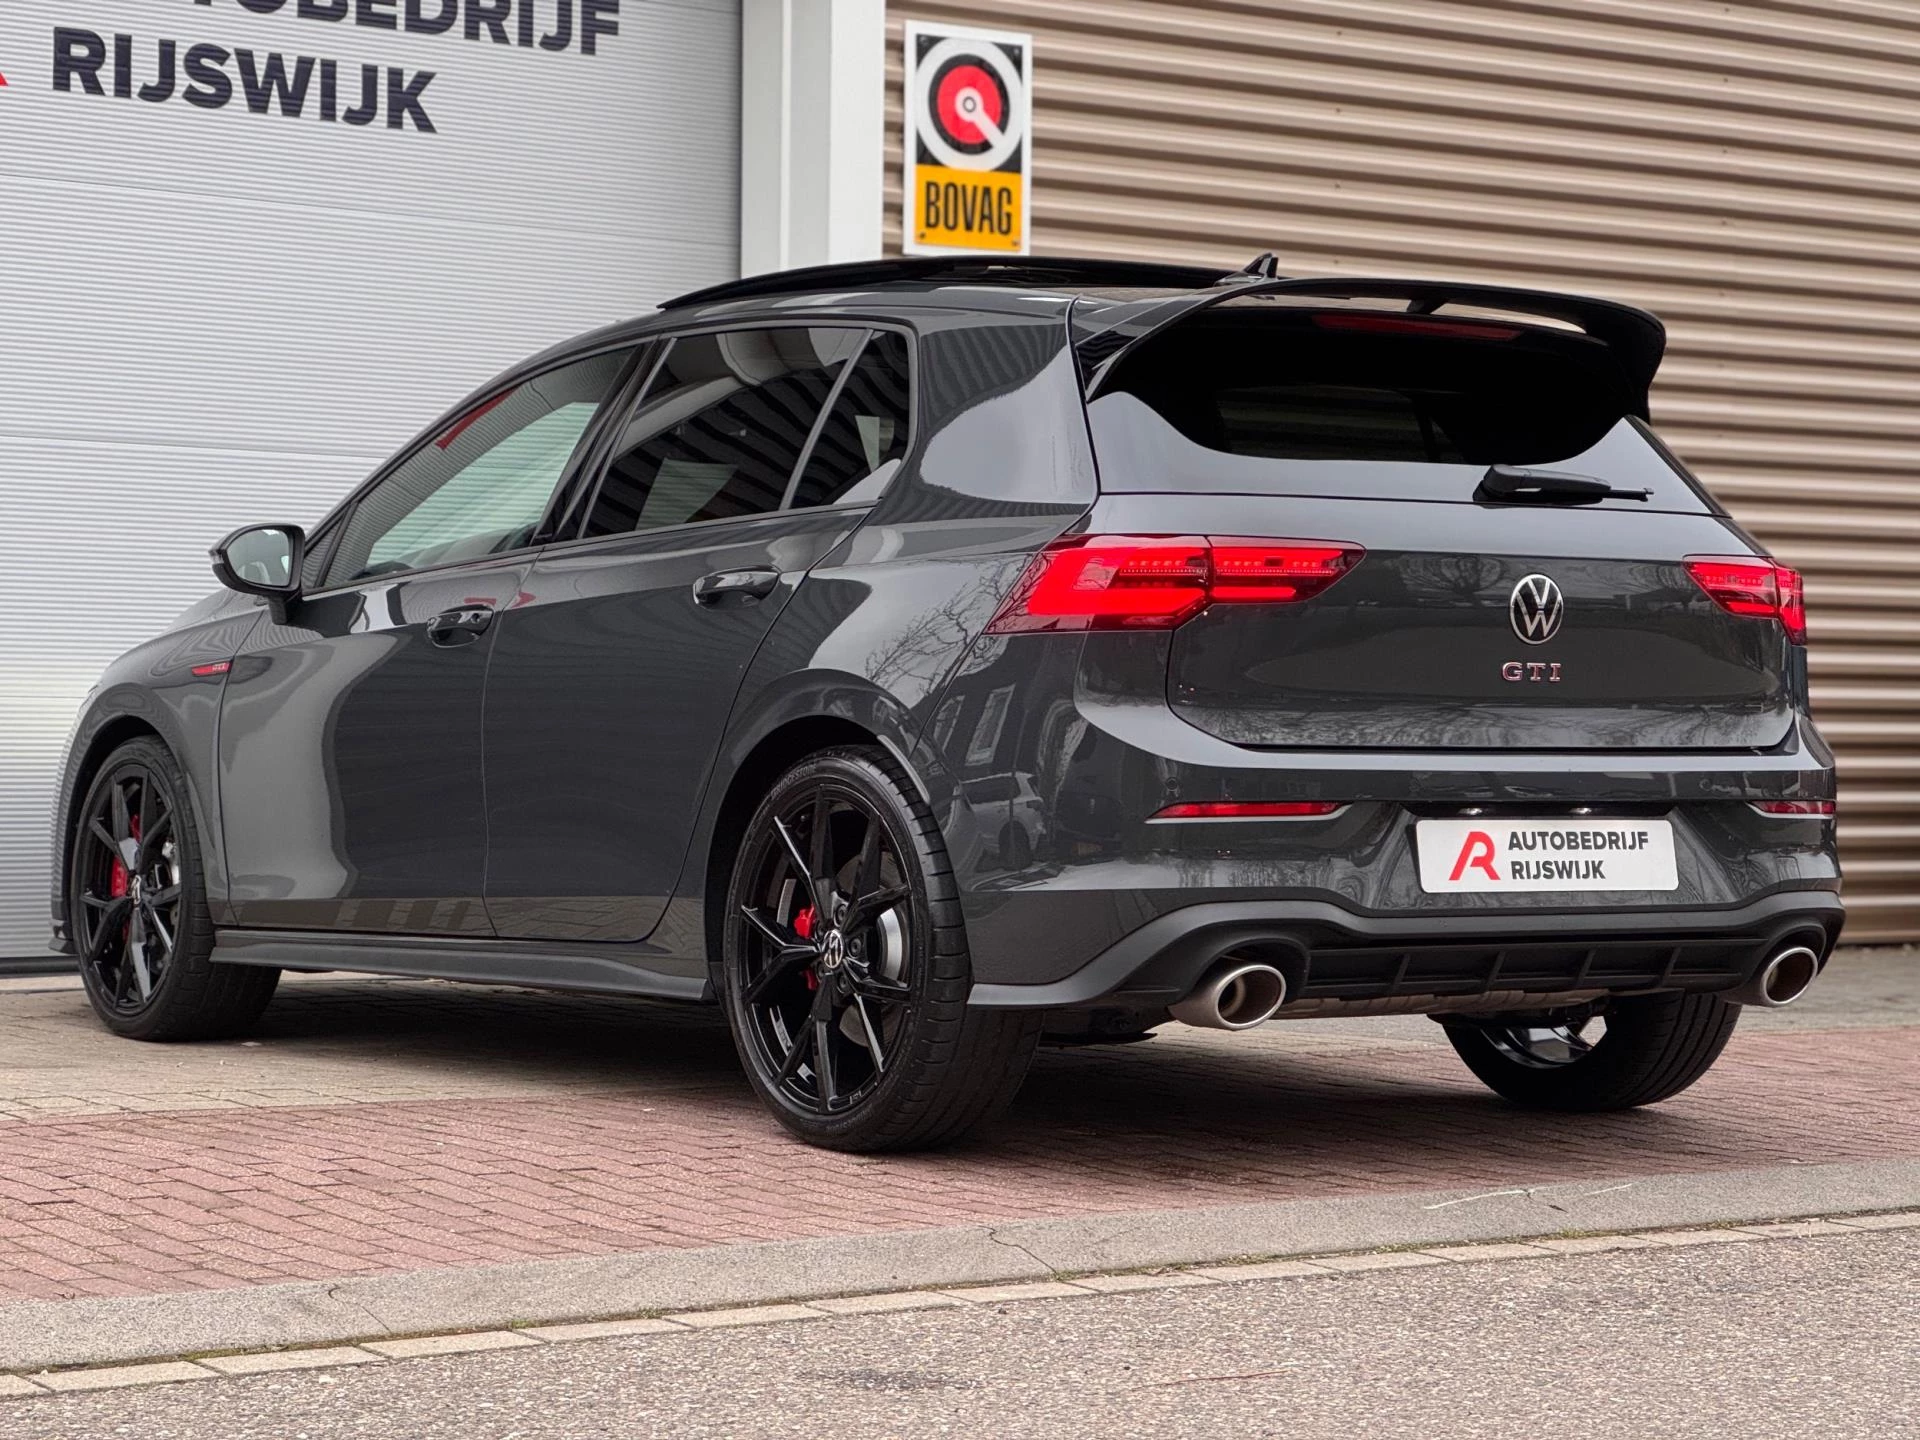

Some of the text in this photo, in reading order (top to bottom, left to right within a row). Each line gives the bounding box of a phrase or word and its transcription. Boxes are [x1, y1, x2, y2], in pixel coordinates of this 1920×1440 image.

[194, 0, 620, 56] DRIJF
[52, 26, 438, 134] RIJSWIJK
[924, 181, 1013, 236] BOVAG
[1502, 661, 1562, 682] GTI
[1508, 831, 1649, 850] AUTOBEDRIJF
[1510, 860, 1606, 880] RIJSWIJK
